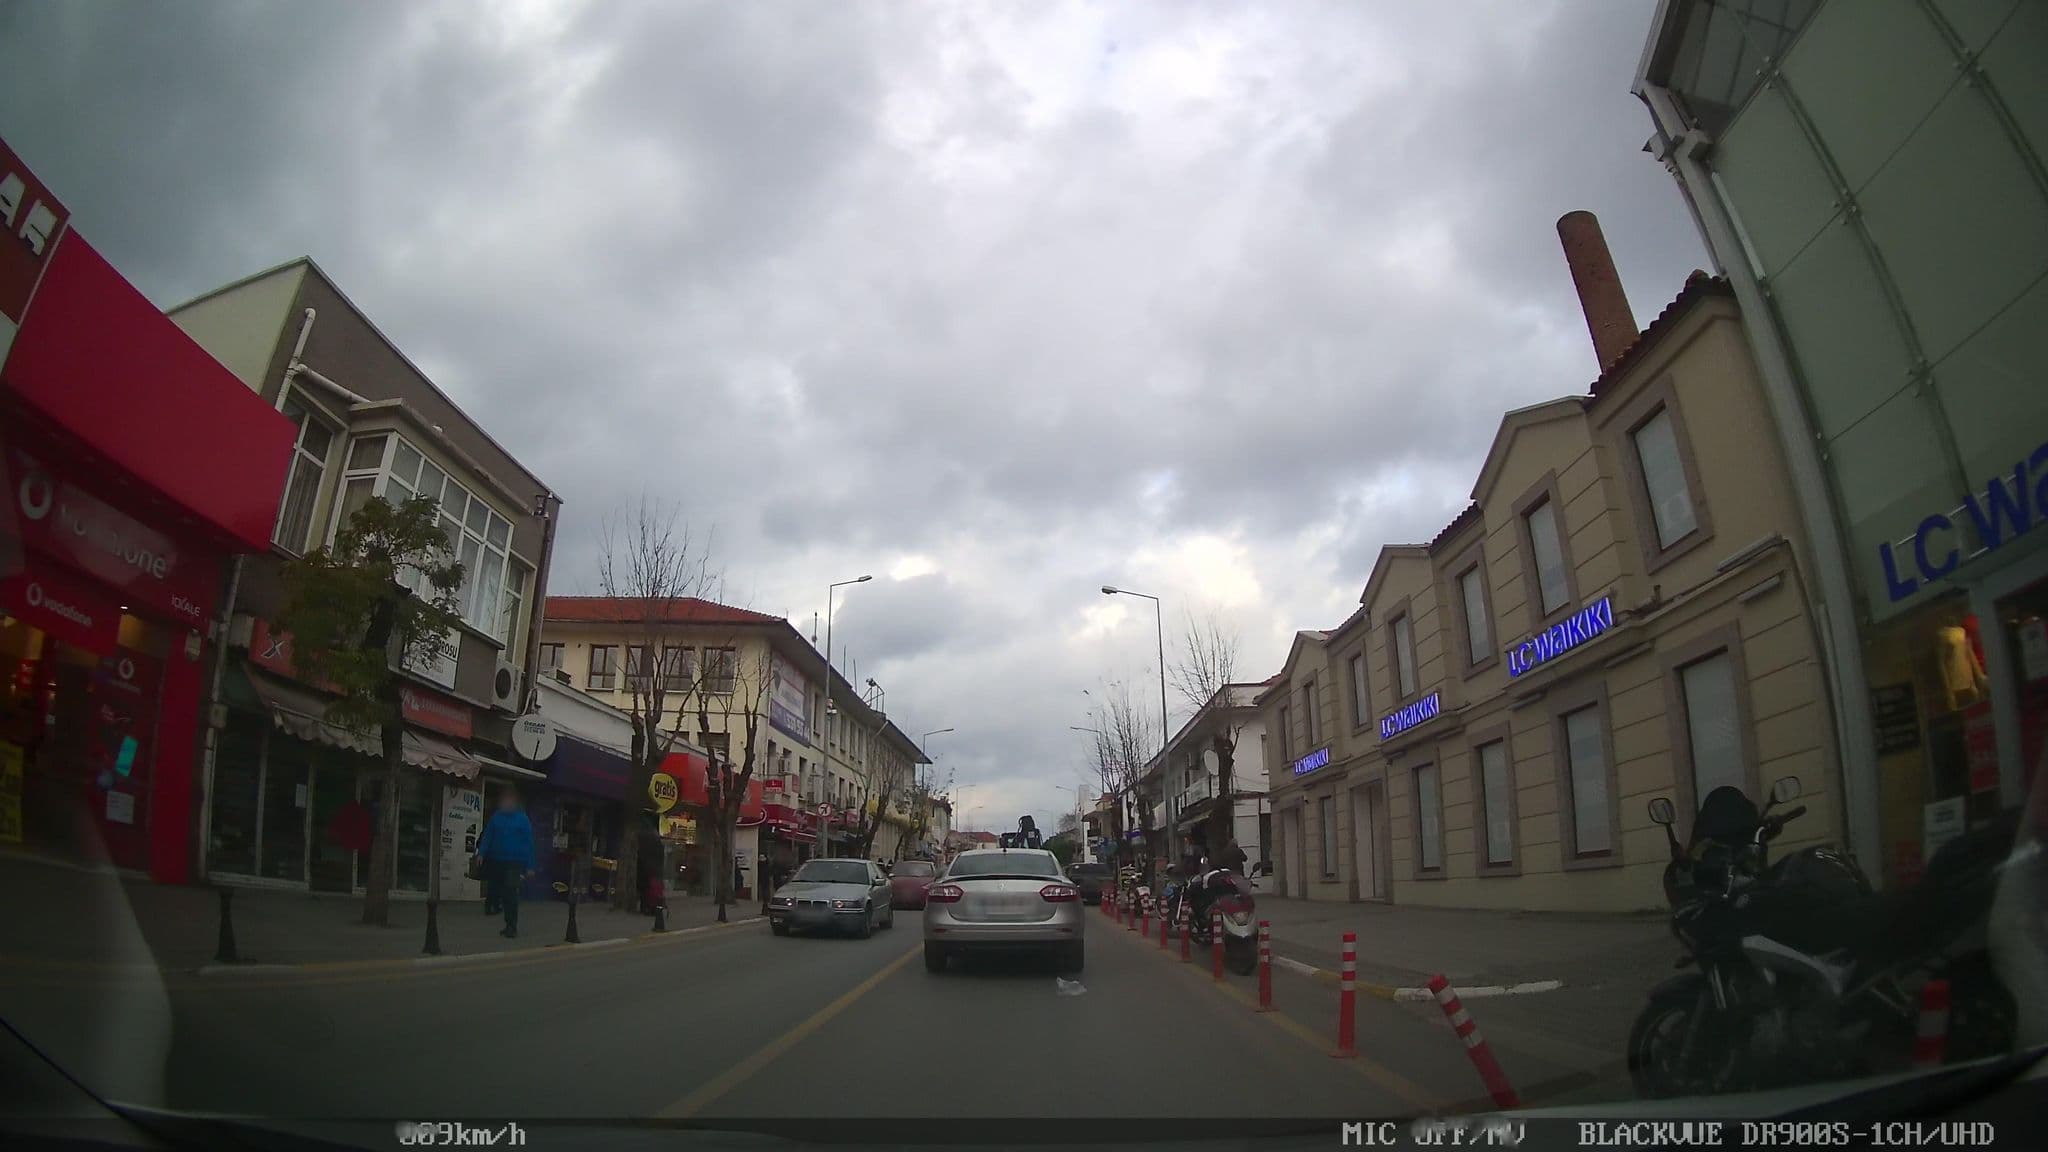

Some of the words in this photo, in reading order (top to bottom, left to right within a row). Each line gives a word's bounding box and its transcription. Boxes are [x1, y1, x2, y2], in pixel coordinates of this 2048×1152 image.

[1879, 514, 1960, 602] LC
[1508, 641, 1534, 678] LC
[1381, 715, 1395, 740] LC
[655, 780, 675, 798] gratis
